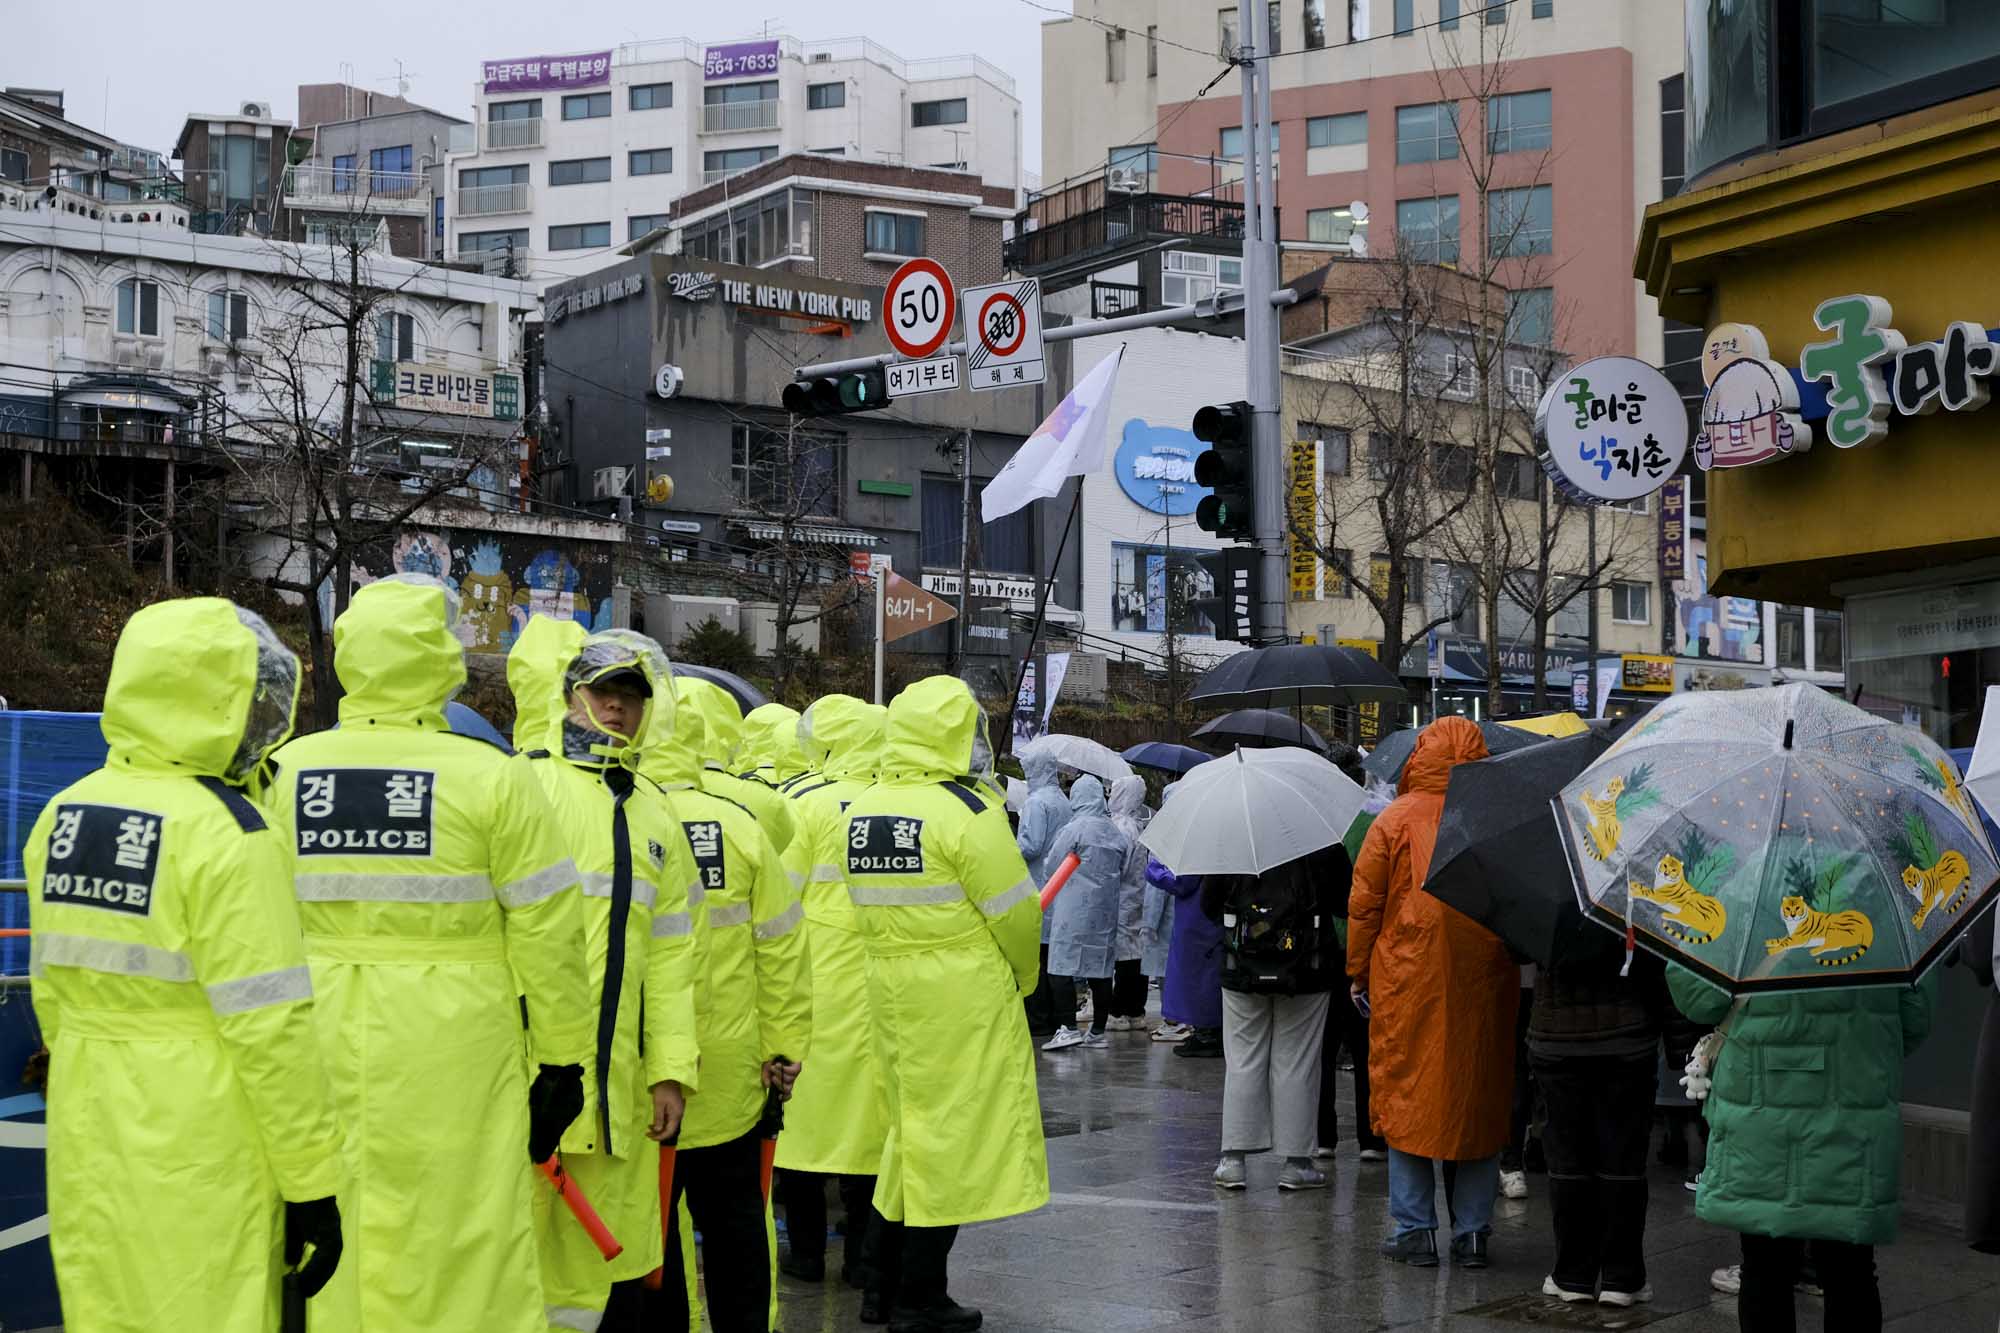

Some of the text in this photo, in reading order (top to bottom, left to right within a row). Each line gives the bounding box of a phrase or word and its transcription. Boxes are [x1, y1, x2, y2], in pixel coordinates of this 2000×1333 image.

[582, 287, 601, 310] NEW
[601, 279, 625, 302] YORK
[624, 273, 643, 296] PUB
[667, 271, 716, 292] Miller
[722, 279, 752, 304] THE
[756, 285, 793, 311] NEW
[798, 291, 839, 317] YORK
[842, 297, 872, 321] PUB
[899, 284, 940, 330] 50
[989, 309, 1015, 341] 30
[398, 372, 490, 405] 크로바만물
[889, 362, 955, 390] 여기부터
[1564, 378, 1647, 430] 굴마을
[1579, 433, 1672, 481] 낙지촌
[1663, 494, 1683, 567] 부동산
[931, 577, 992, 597] Himaya
[1499, 651, 1574, 673] HARUANG
[299, 828, 428, 849] POLICE
[690, 823, 720, 857] 찰
[848, 855, 921, 870] POLICE
[43, 872, 149, 907] POLICE
